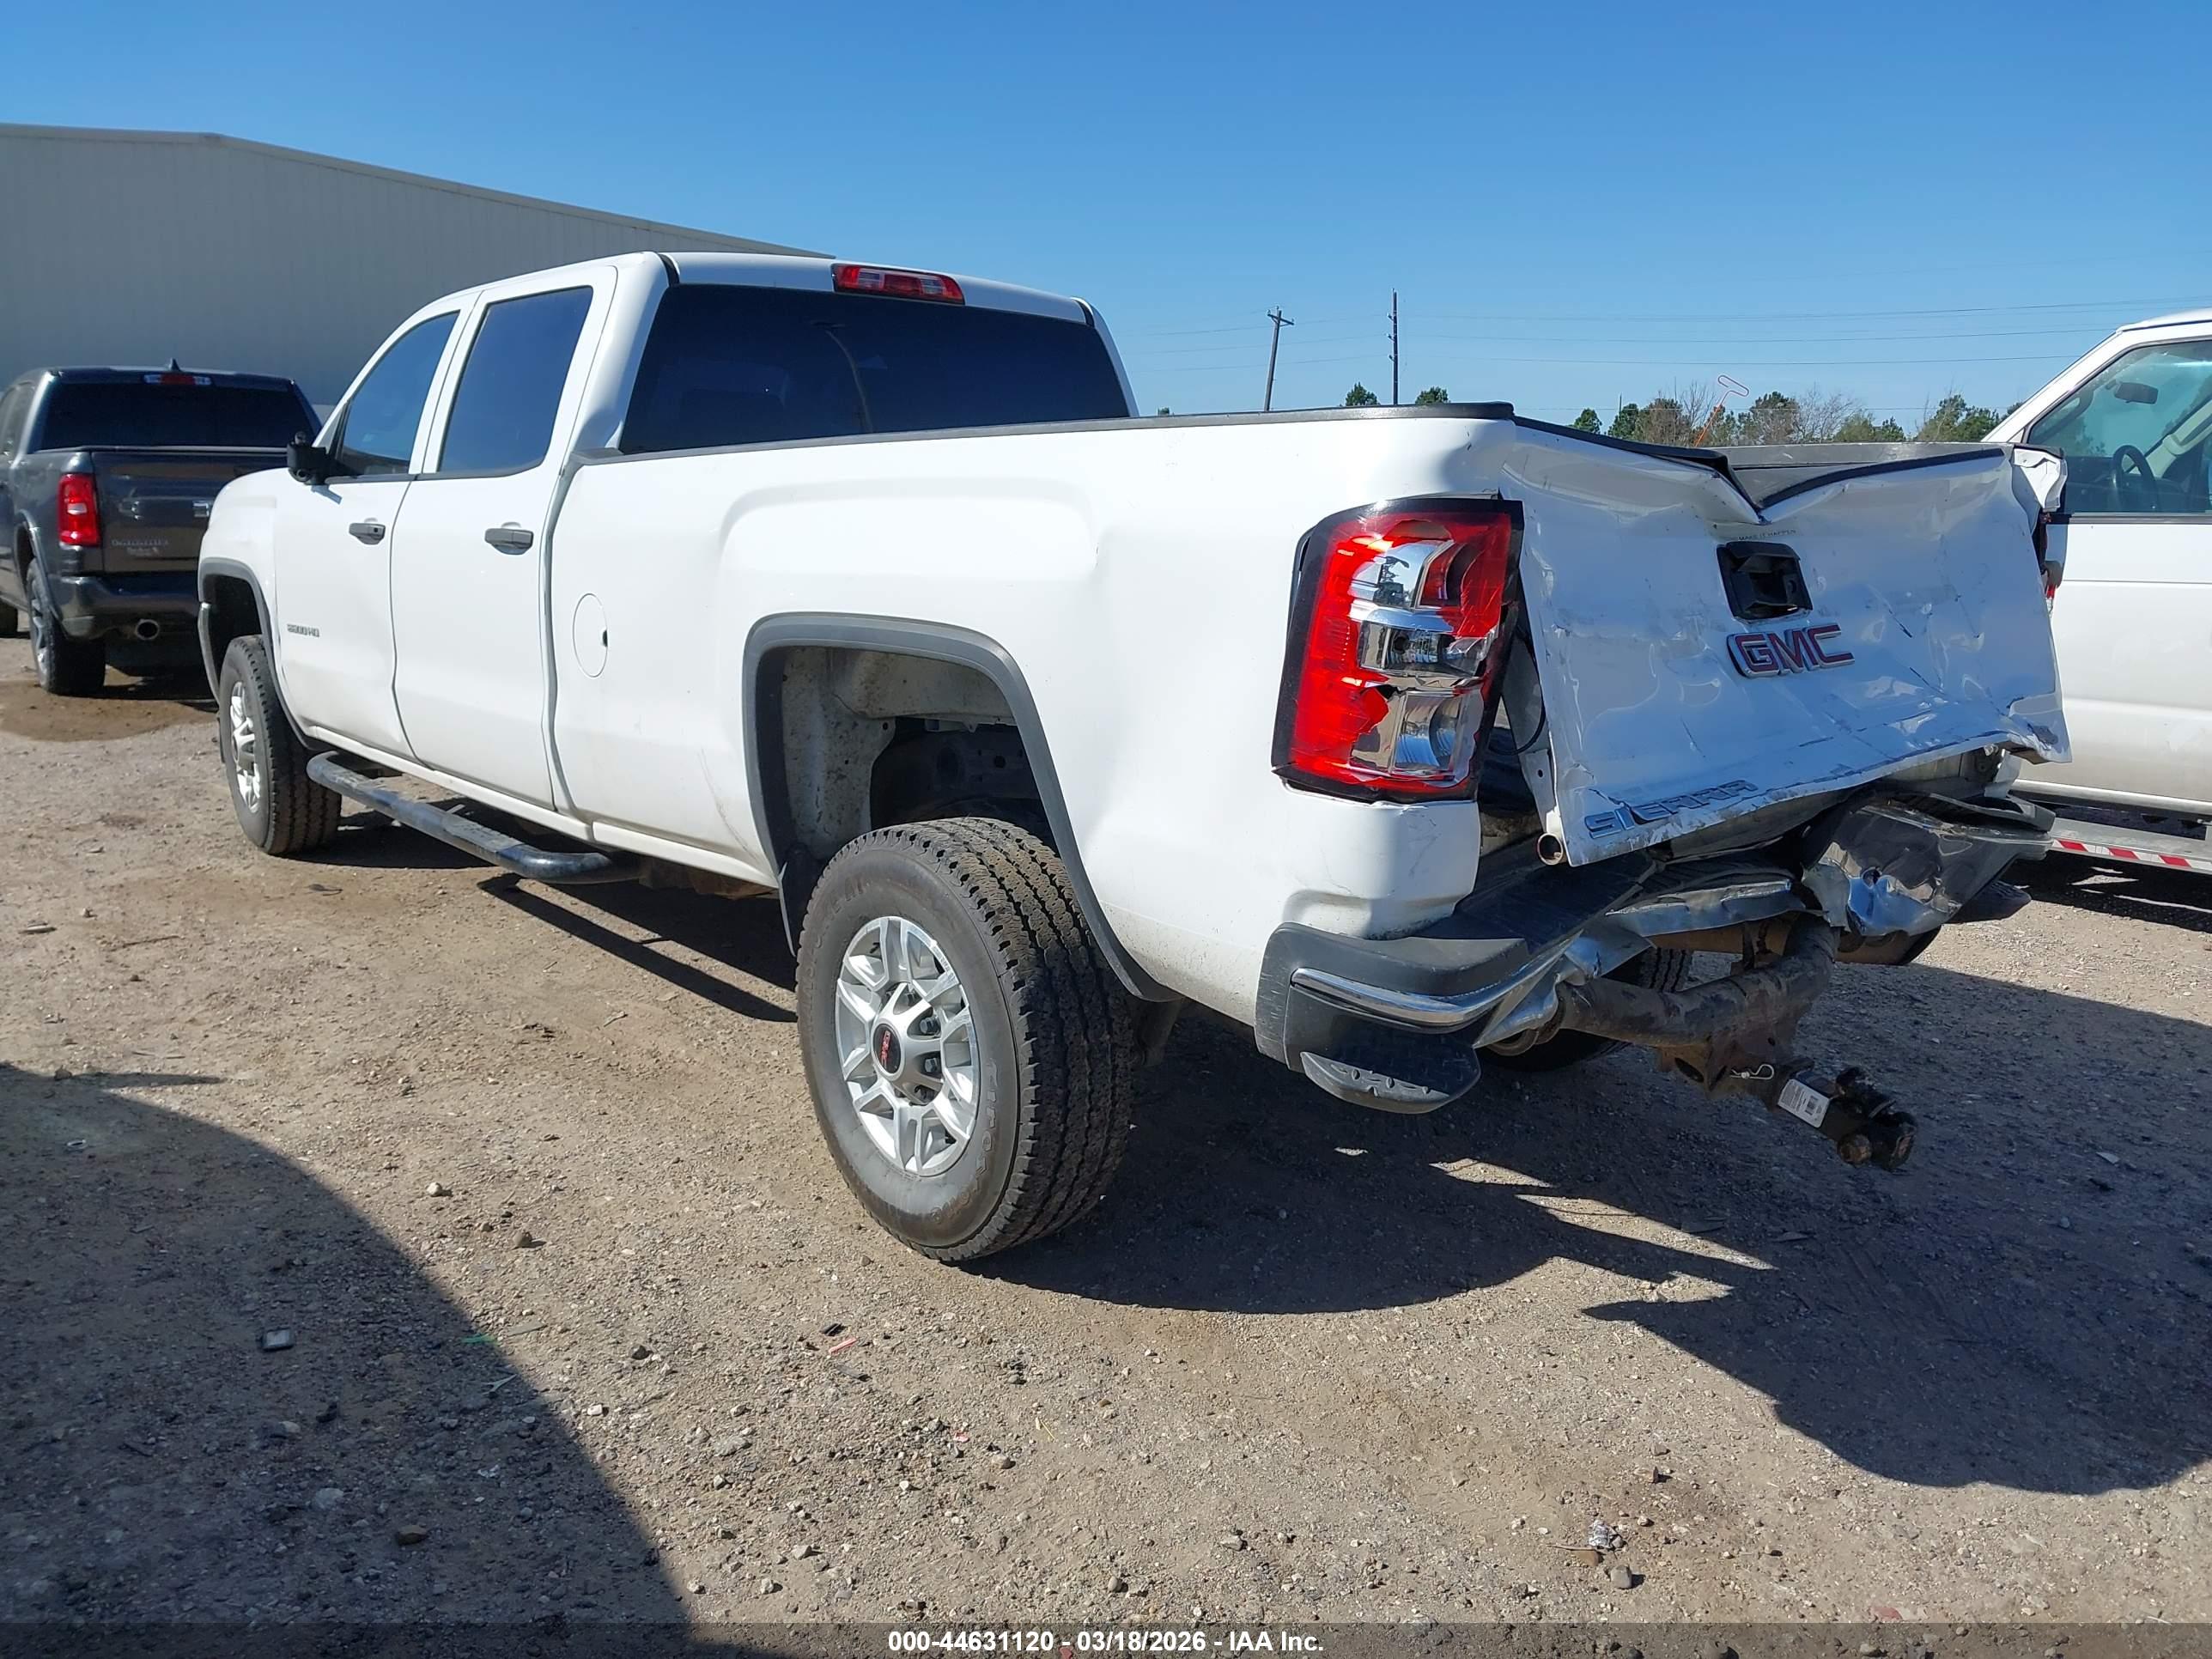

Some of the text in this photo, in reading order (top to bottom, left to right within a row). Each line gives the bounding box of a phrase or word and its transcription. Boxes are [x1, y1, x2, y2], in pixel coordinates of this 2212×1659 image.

[1727, 624, 1855, 678] GMC
[1584, 780, 1759, 839] SIERRA
[881, 1030, 890, 1069] GMC
